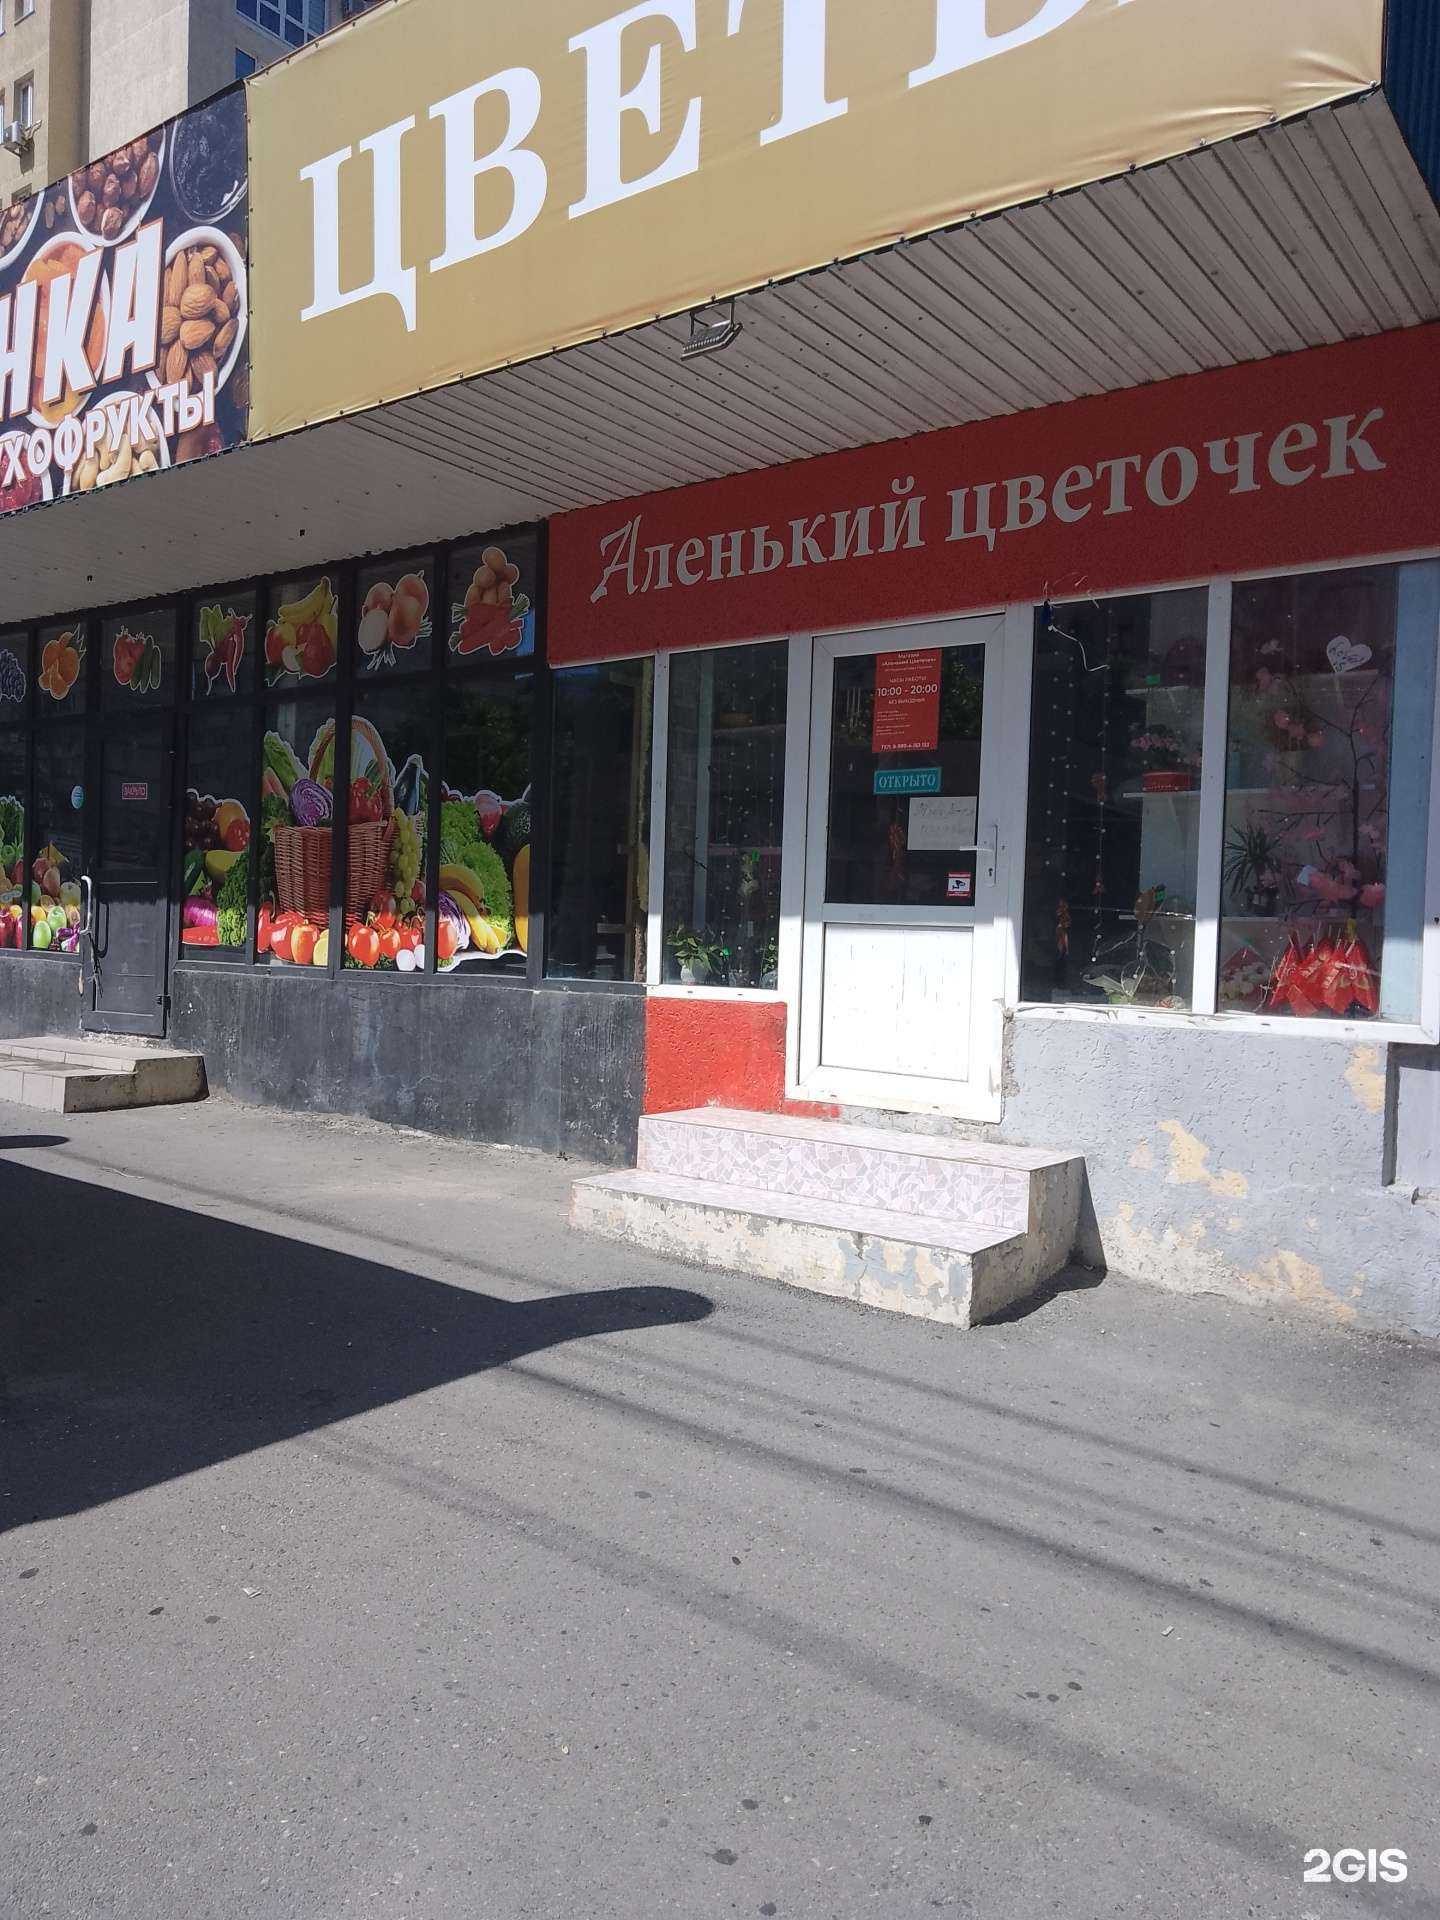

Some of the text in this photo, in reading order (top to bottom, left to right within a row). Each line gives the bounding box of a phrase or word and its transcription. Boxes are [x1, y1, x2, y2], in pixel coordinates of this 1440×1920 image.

[0, 371, 215, 488] ХОФРУКТЫ
[590, 477, 927, 604] Аленький
[877, 686, 902, 697] 10:00
[910, 683, 938, 695] 20:00
[879, 773, 936, 788] ОТКРЫТО
